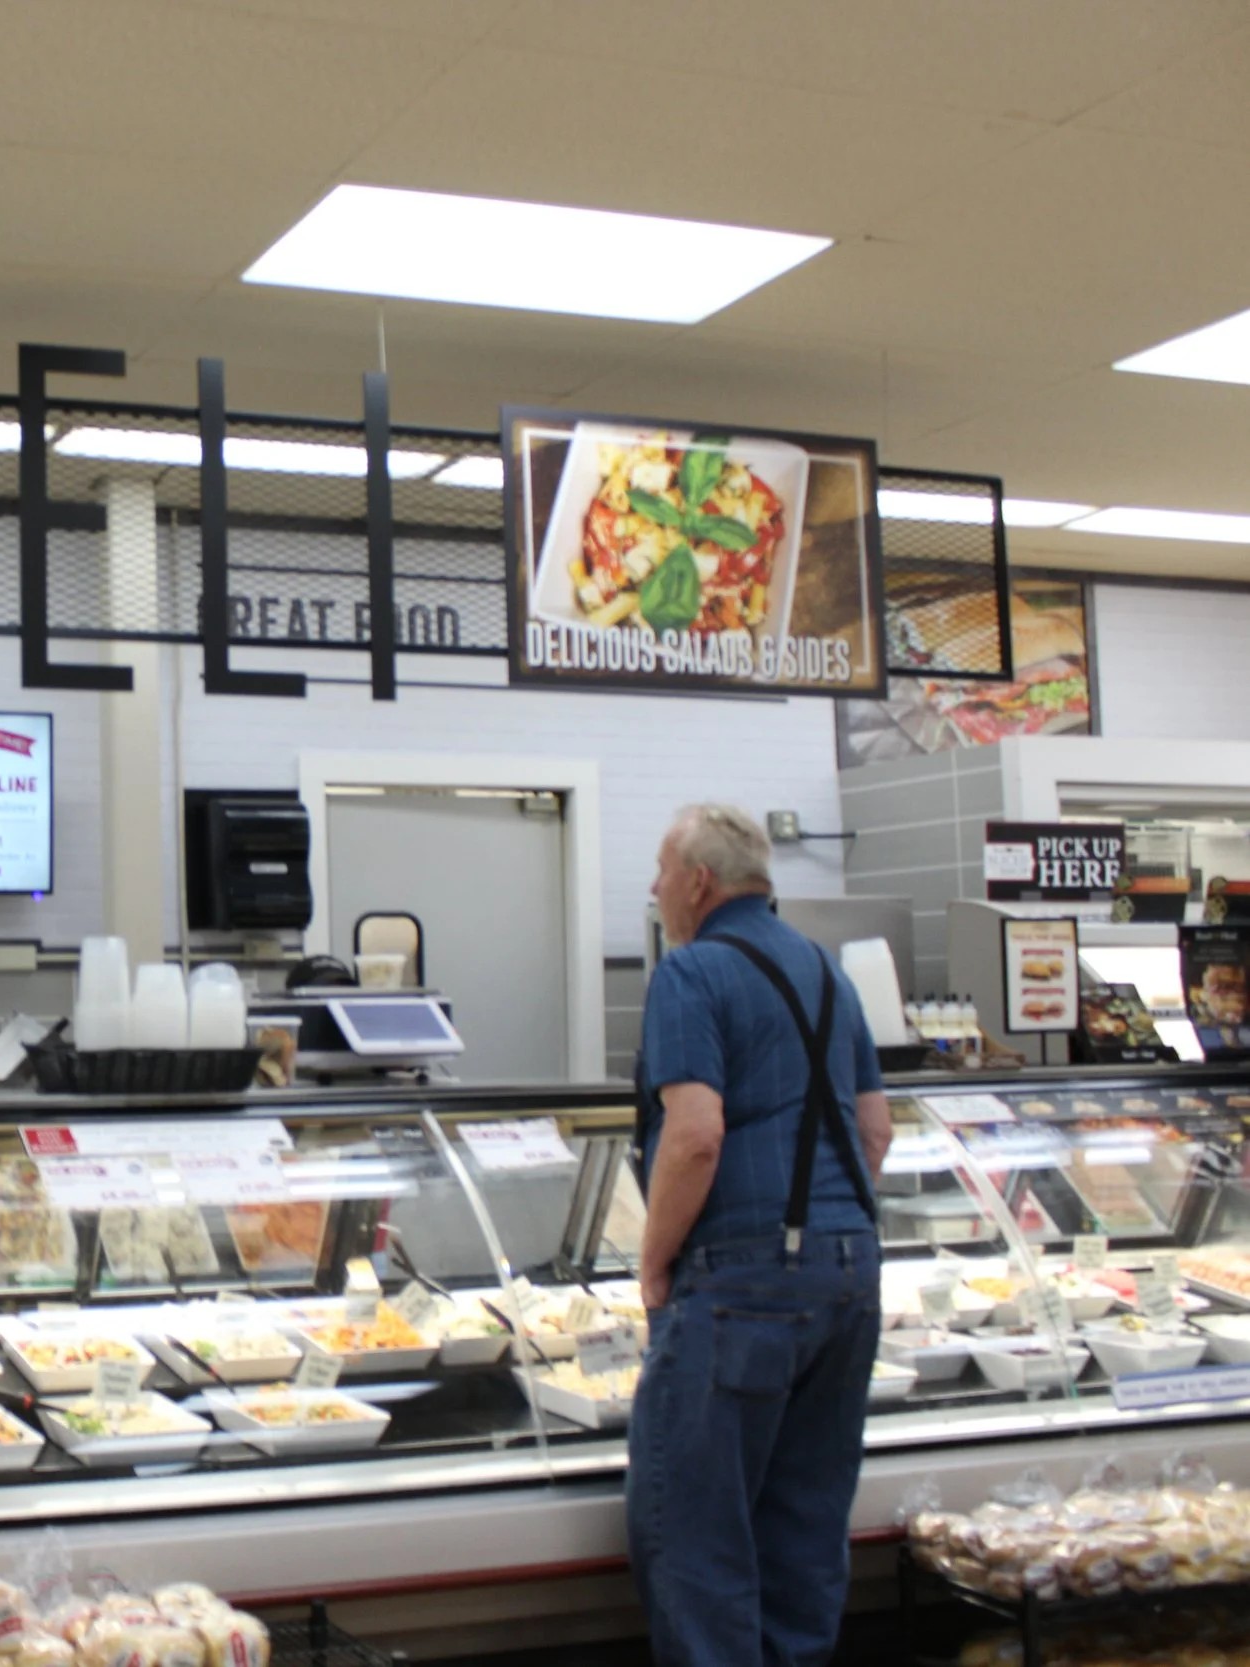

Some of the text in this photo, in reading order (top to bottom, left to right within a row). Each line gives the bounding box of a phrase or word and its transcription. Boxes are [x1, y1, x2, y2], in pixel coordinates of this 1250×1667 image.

[198, 594, 335, 642] REAT
[525, 621, 851, 681] DELICIOUS SALADS & SIDES
[1037, 836, 1122, 859] PICK UP
